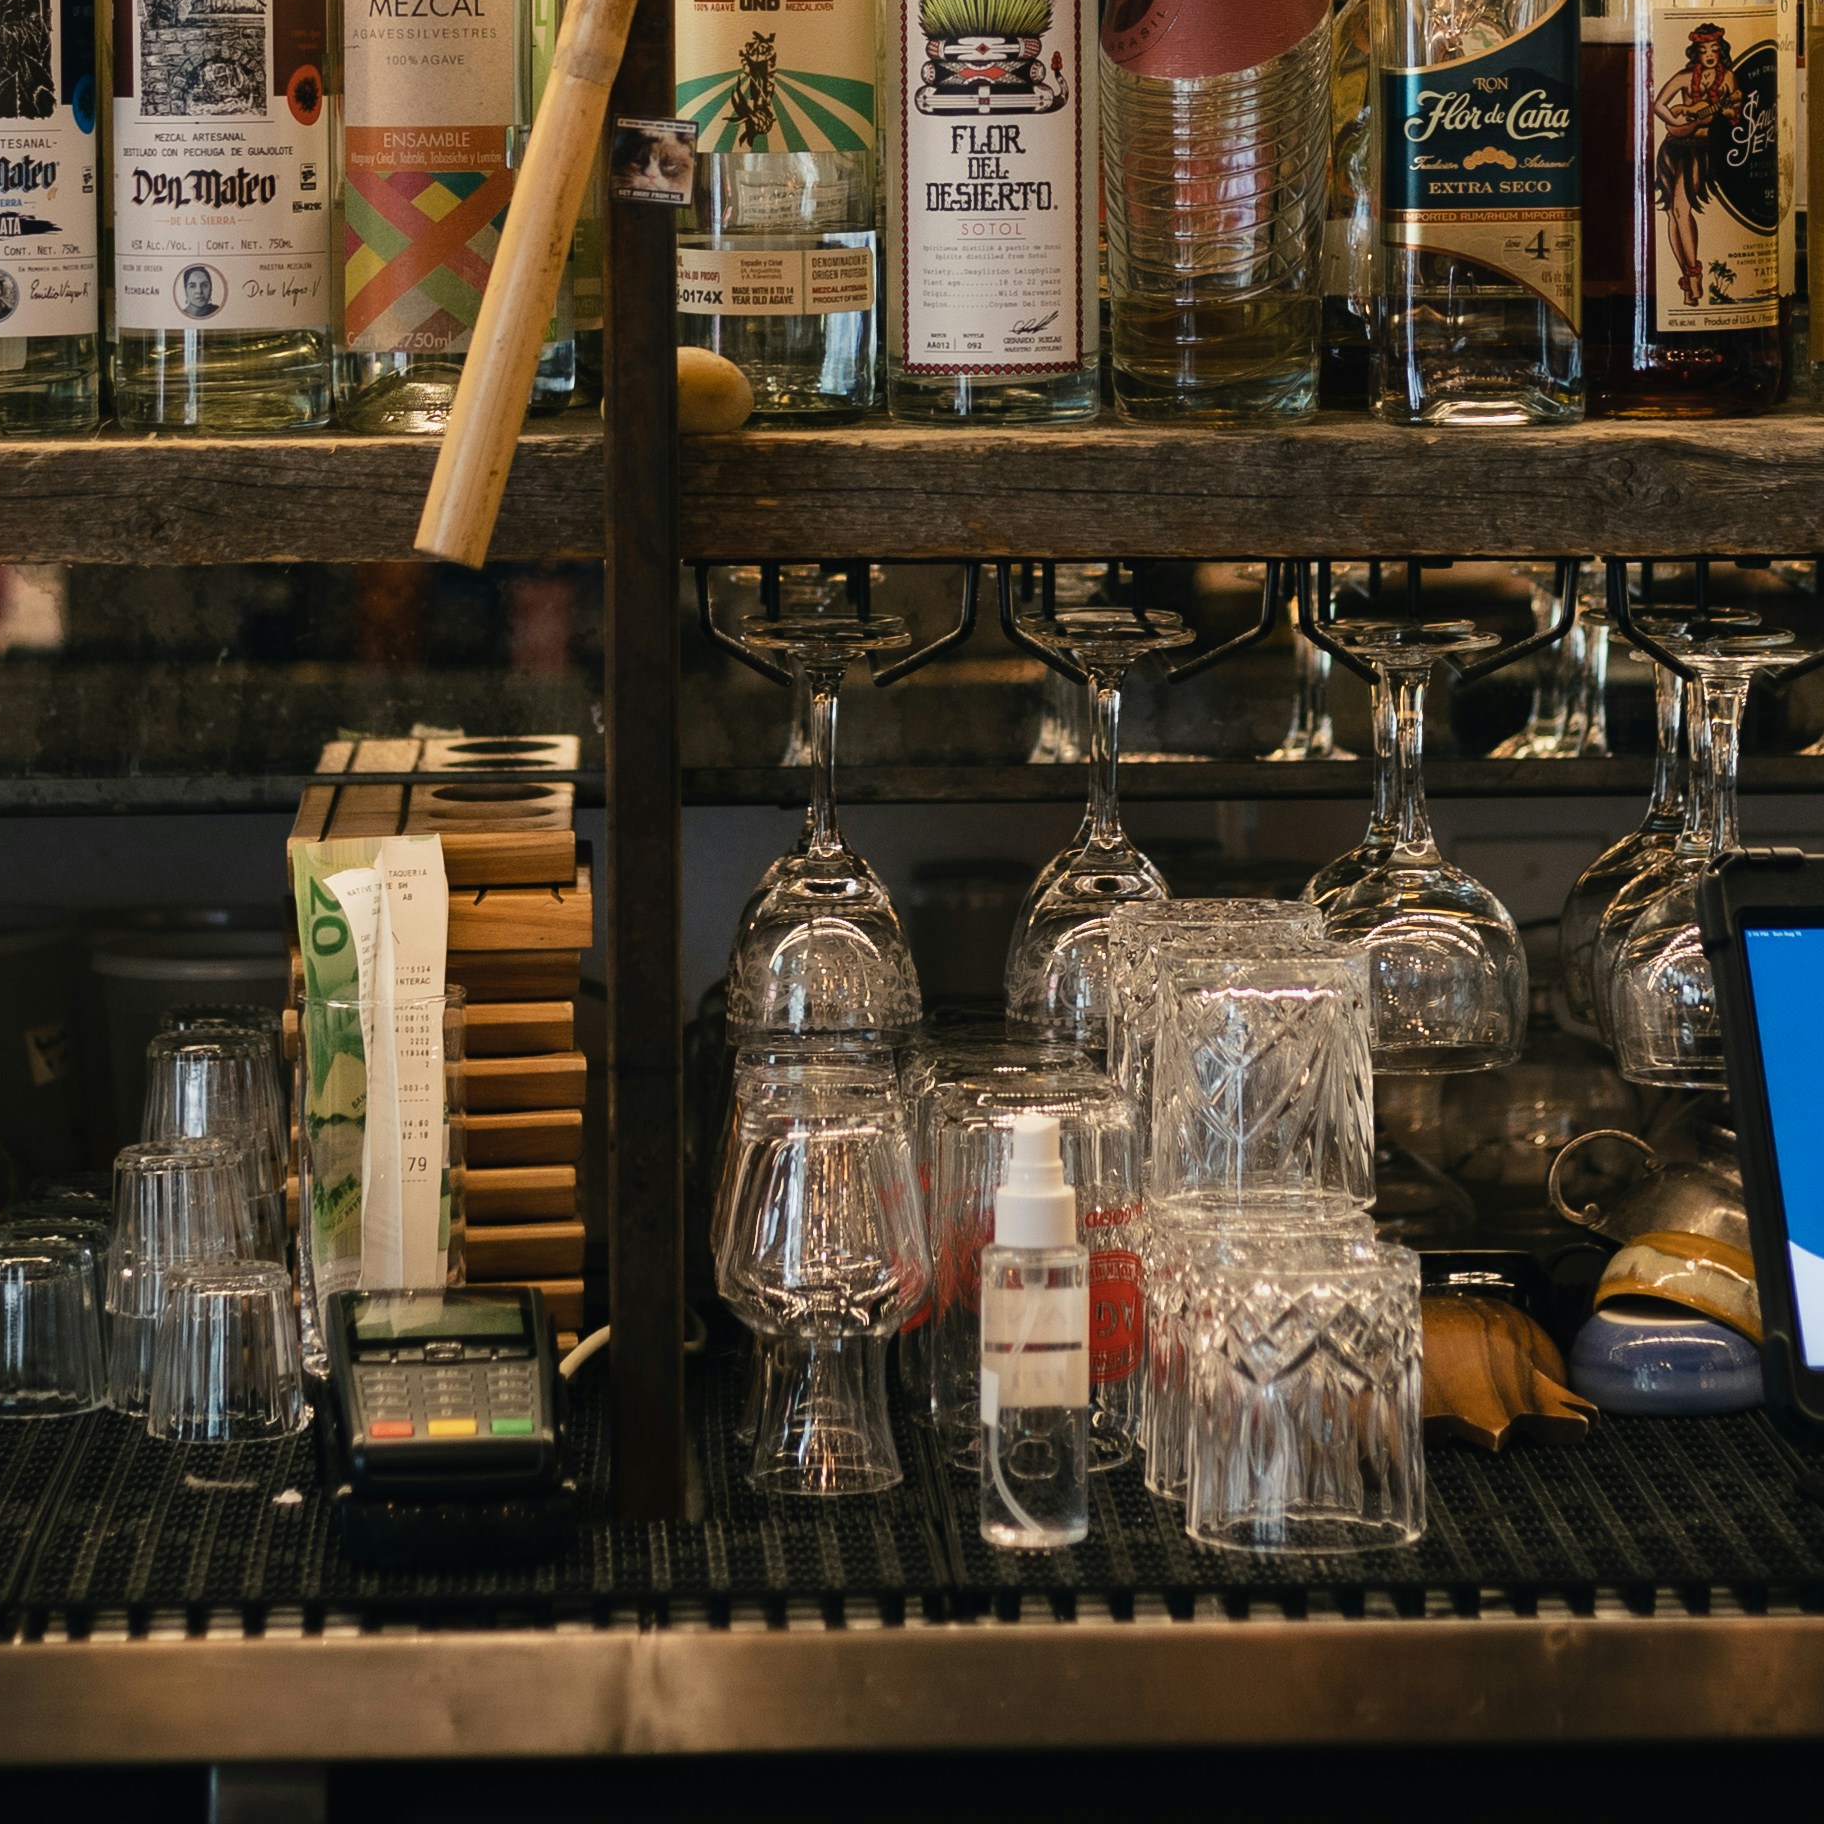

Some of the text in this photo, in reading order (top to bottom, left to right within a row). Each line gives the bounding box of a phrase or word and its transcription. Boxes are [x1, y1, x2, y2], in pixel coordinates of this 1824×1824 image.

[386, 54, 465, 66] 100% AGAVE
[1472, 77, 1509, 92] RON
[1404, 89, 1570, 143] Flor de Caña
[383, 131, 470, 148] ENSAMBLE
[951, 125, 1026, 155] FLOR
[184, 145, 294, 158] PECHUGA DE GUAJOLOTE
[967, 155, 1009, 180] DEL
[131, 167, 276, 210] Don Mateo
[1429, 180, 1551, 195] EXTRA SECO
[961, 223, 1022, 237] SOTOL
[388, 869, 428, 877] TAQUERIA
